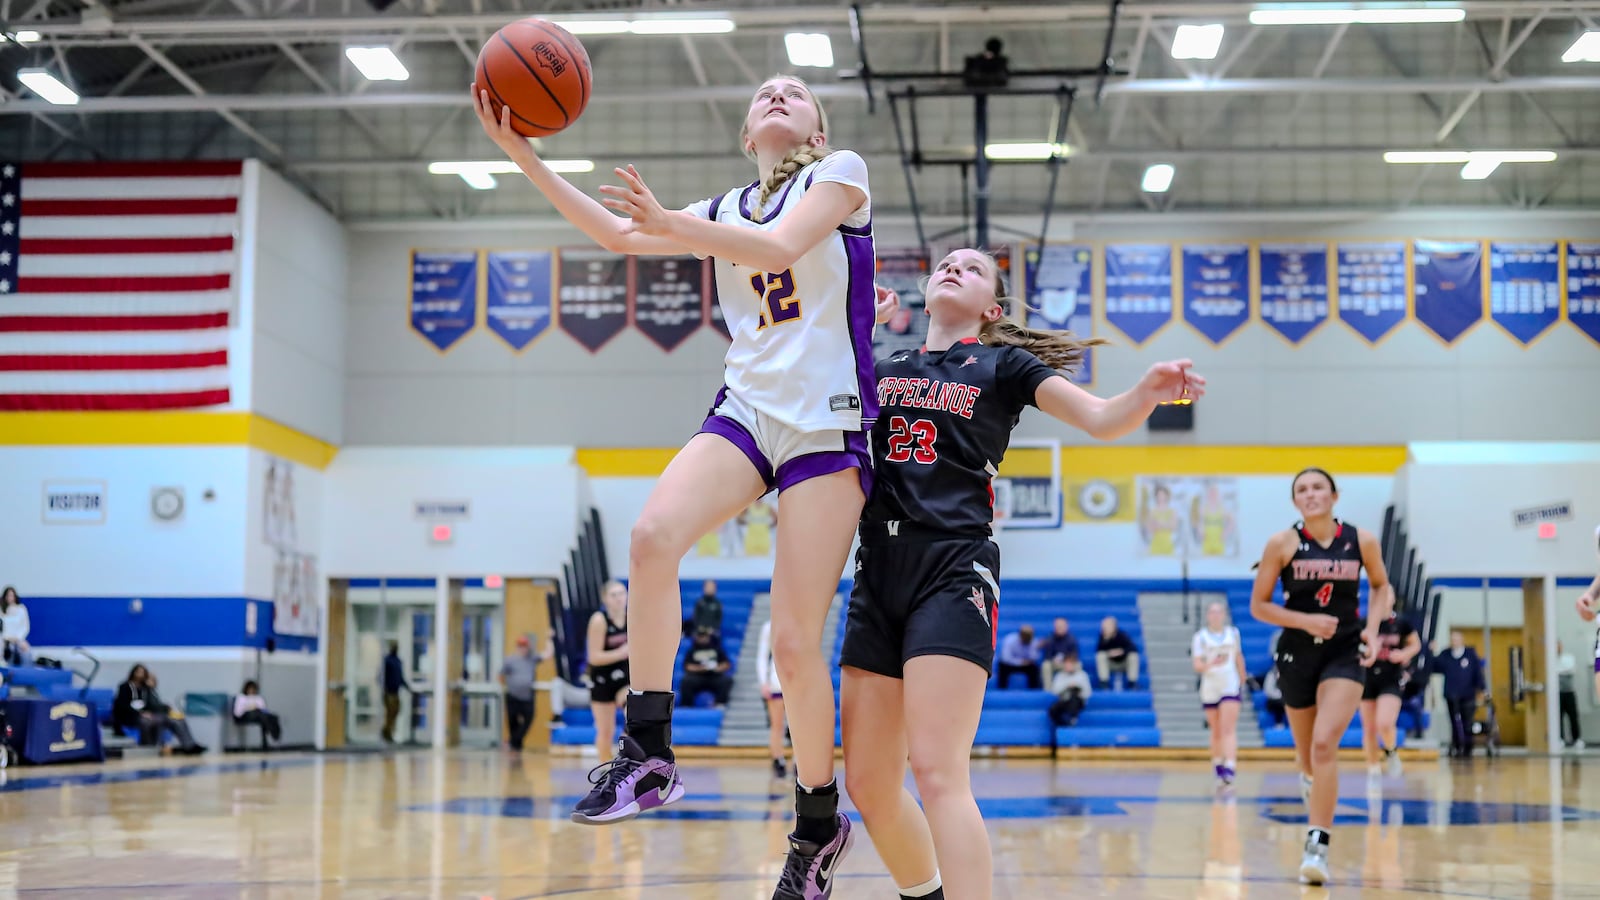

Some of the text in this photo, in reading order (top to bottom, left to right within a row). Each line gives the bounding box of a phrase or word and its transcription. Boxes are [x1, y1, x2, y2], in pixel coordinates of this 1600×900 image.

[535, 44, 563, 74] OHSAA
[750, 266, 802, 331] 12
[885, 416, 938, 464] 23
[47, 495, 101, 511] VISITOR
[1314, 581, 1334, 607] 4
